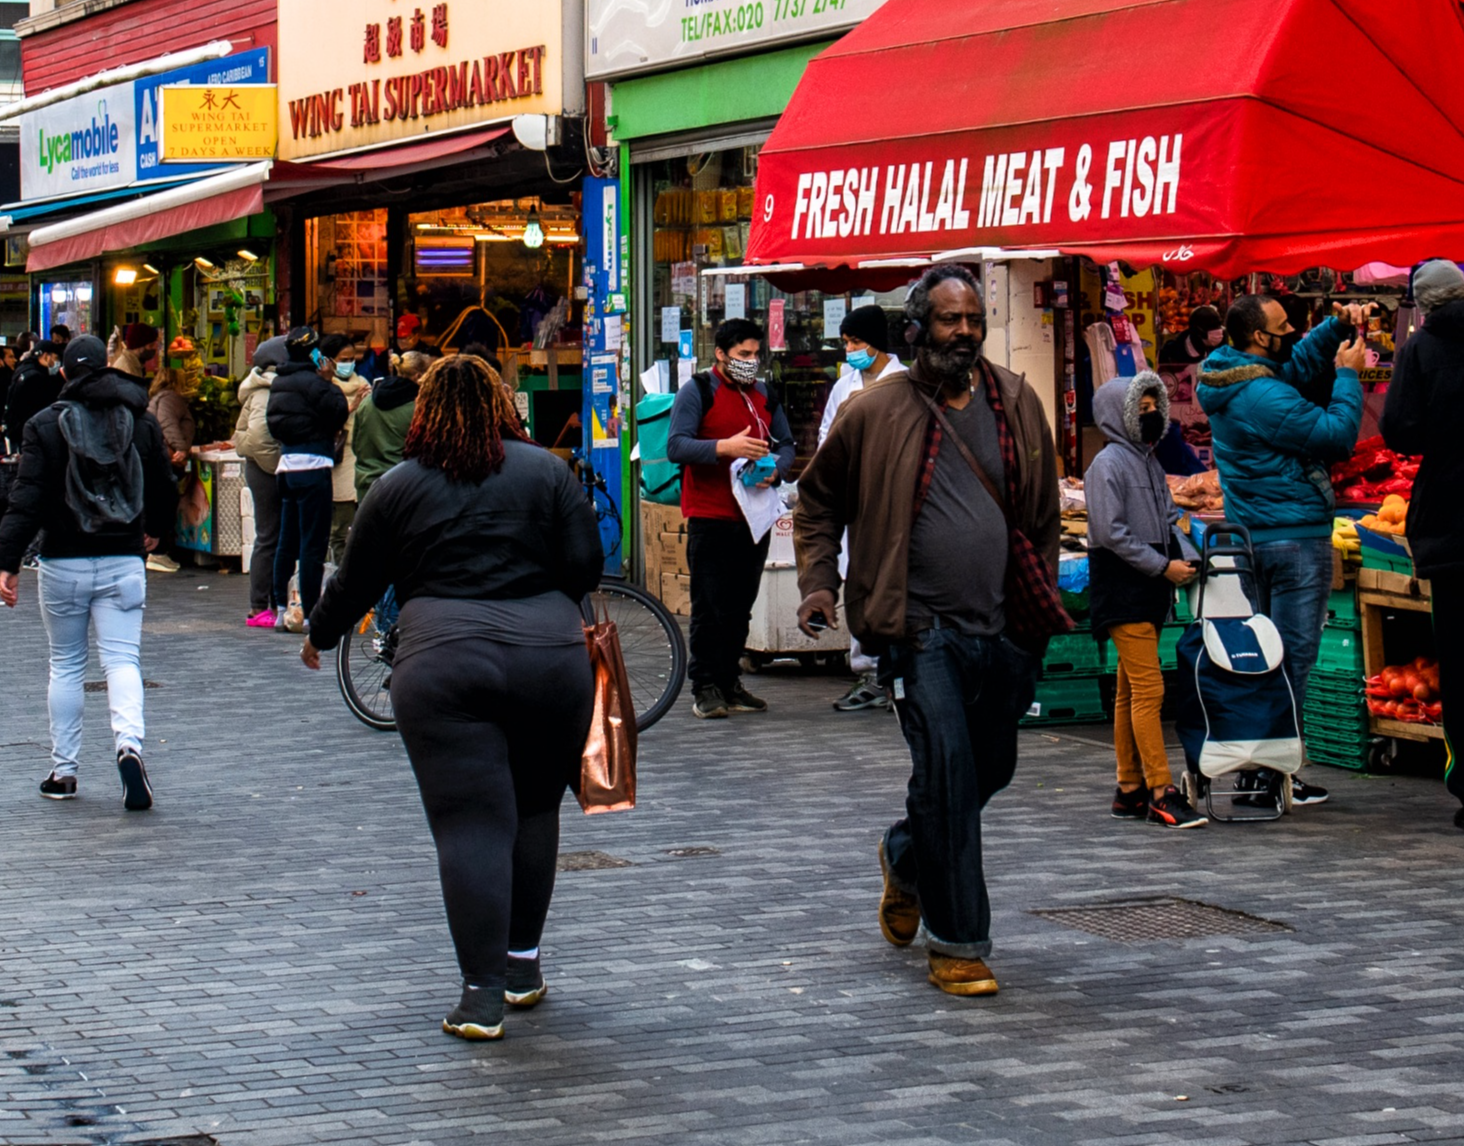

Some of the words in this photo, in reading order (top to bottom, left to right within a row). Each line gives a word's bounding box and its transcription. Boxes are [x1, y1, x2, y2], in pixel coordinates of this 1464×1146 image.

[363, 3, 448, 64] 超級市場
[222, 65, 253, 83] CARIBBEAN
[199, 89, 242, 111] 永大
[288, 87, 344, 141] WING
[348, 79, 381, 128] TAI
[383, 44, 546, 122] SUPERMARKET
[191, 112, 225, 122] WING
[232, 112, 251, 121] TAI
[172, 123, 269, 133] SUPERMARKET
[39, 114, 119, 175] Lycamobile
[203, 136, 238, 146] OPEN
[169, 147, 176, 156] 7
[181, 147, 216, 157] DAYS
[221, 147, 230, 156] A
[235, 146, 272, 156] WEEK
[71, 166, 80, 180] Call
[109, 160, 120, 174] less
[791, 166, 879, 240] FRESH
[879, 157, 969, 234] HALAL
[976, 147, 1066, 229] MEAT
[1068, 143, 1093, 223] &
[1100, 133, 1183, 219] FISH
[763, 194, 774, 223] 9
[1357, 369, 1392, 380] RICES
